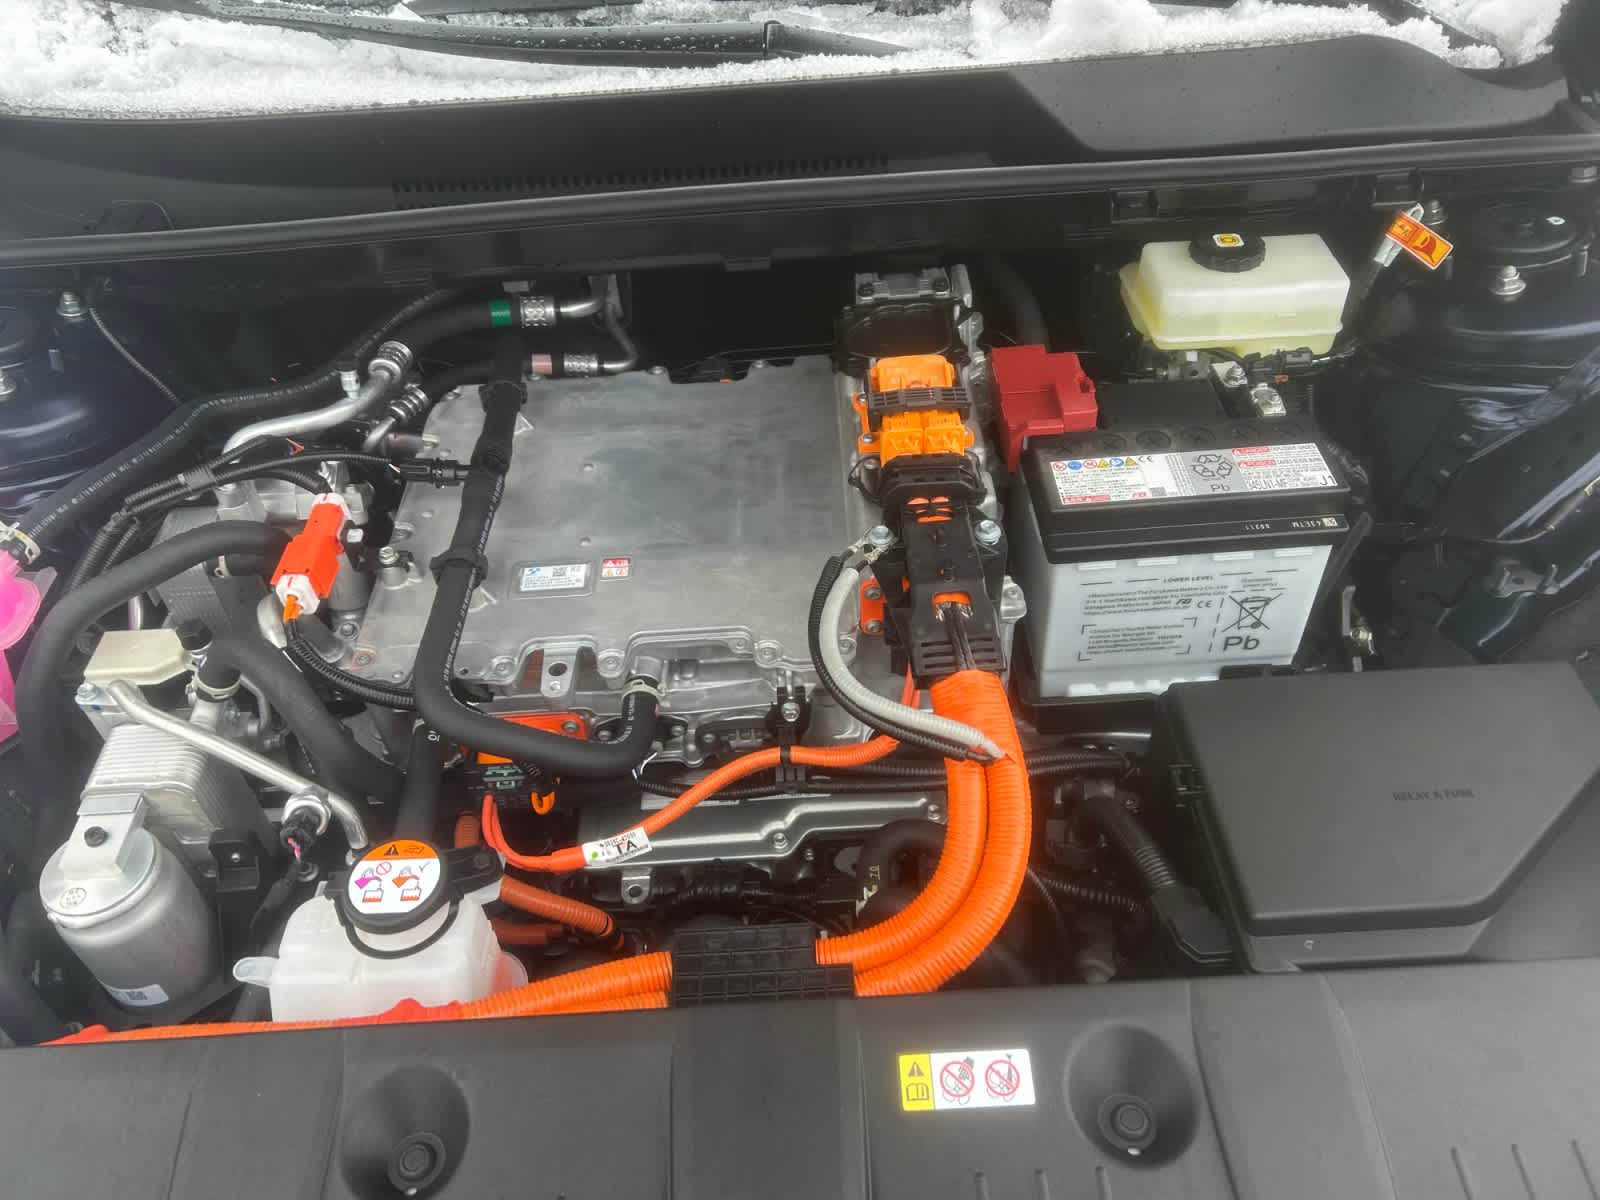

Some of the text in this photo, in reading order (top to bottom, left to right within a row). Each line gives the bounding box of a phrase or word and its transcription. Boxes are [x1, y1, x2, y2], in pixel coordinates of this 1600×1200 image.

[1210, 484, 1231, 492] Pb
[1223, 635, 1260, 652] Pb
[616, 839, 638, 855] TA
